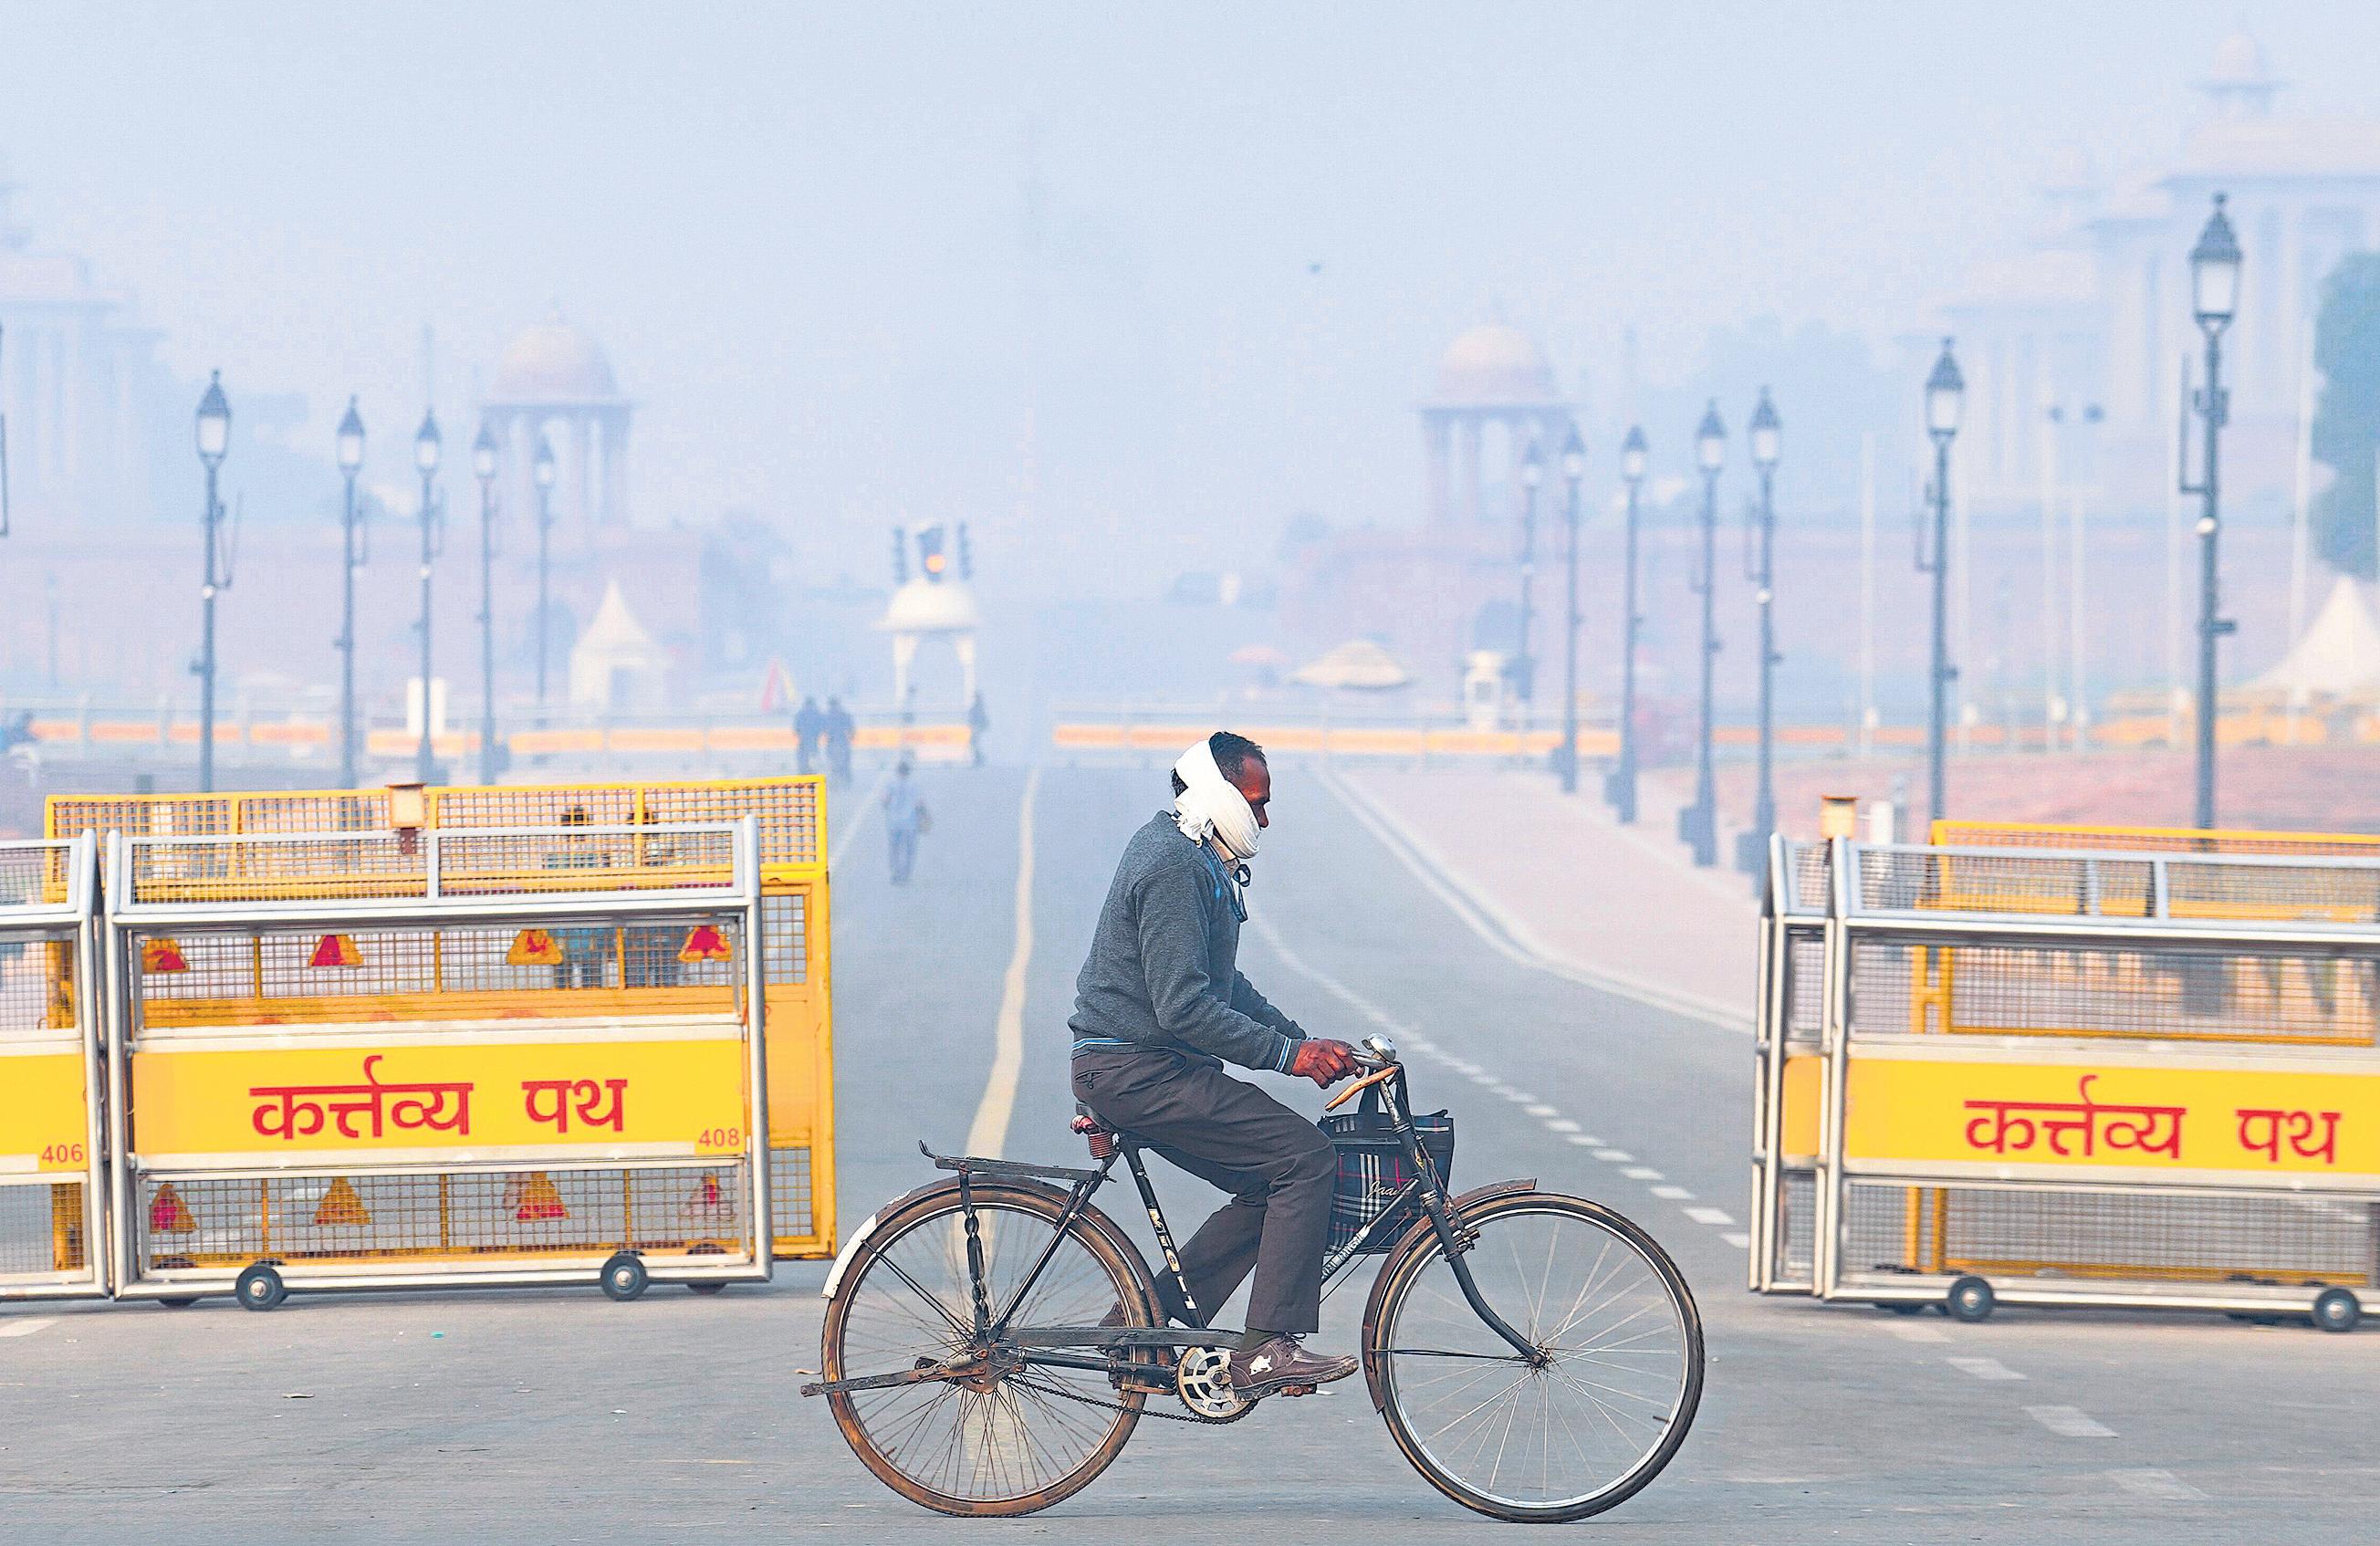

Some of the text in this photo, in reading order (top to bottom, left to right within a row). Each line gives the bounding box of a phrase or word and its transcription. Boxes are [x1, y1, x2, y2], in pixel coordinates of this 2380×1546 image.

[248, 1055, 629, 1140] कर्त्तव्य पथ
[1964, 1074, 2342, 1165] कर्त्तव्य पथ
[41, 1144, 84, 1164] 406
[698, 1127, 740, 1147] 408
